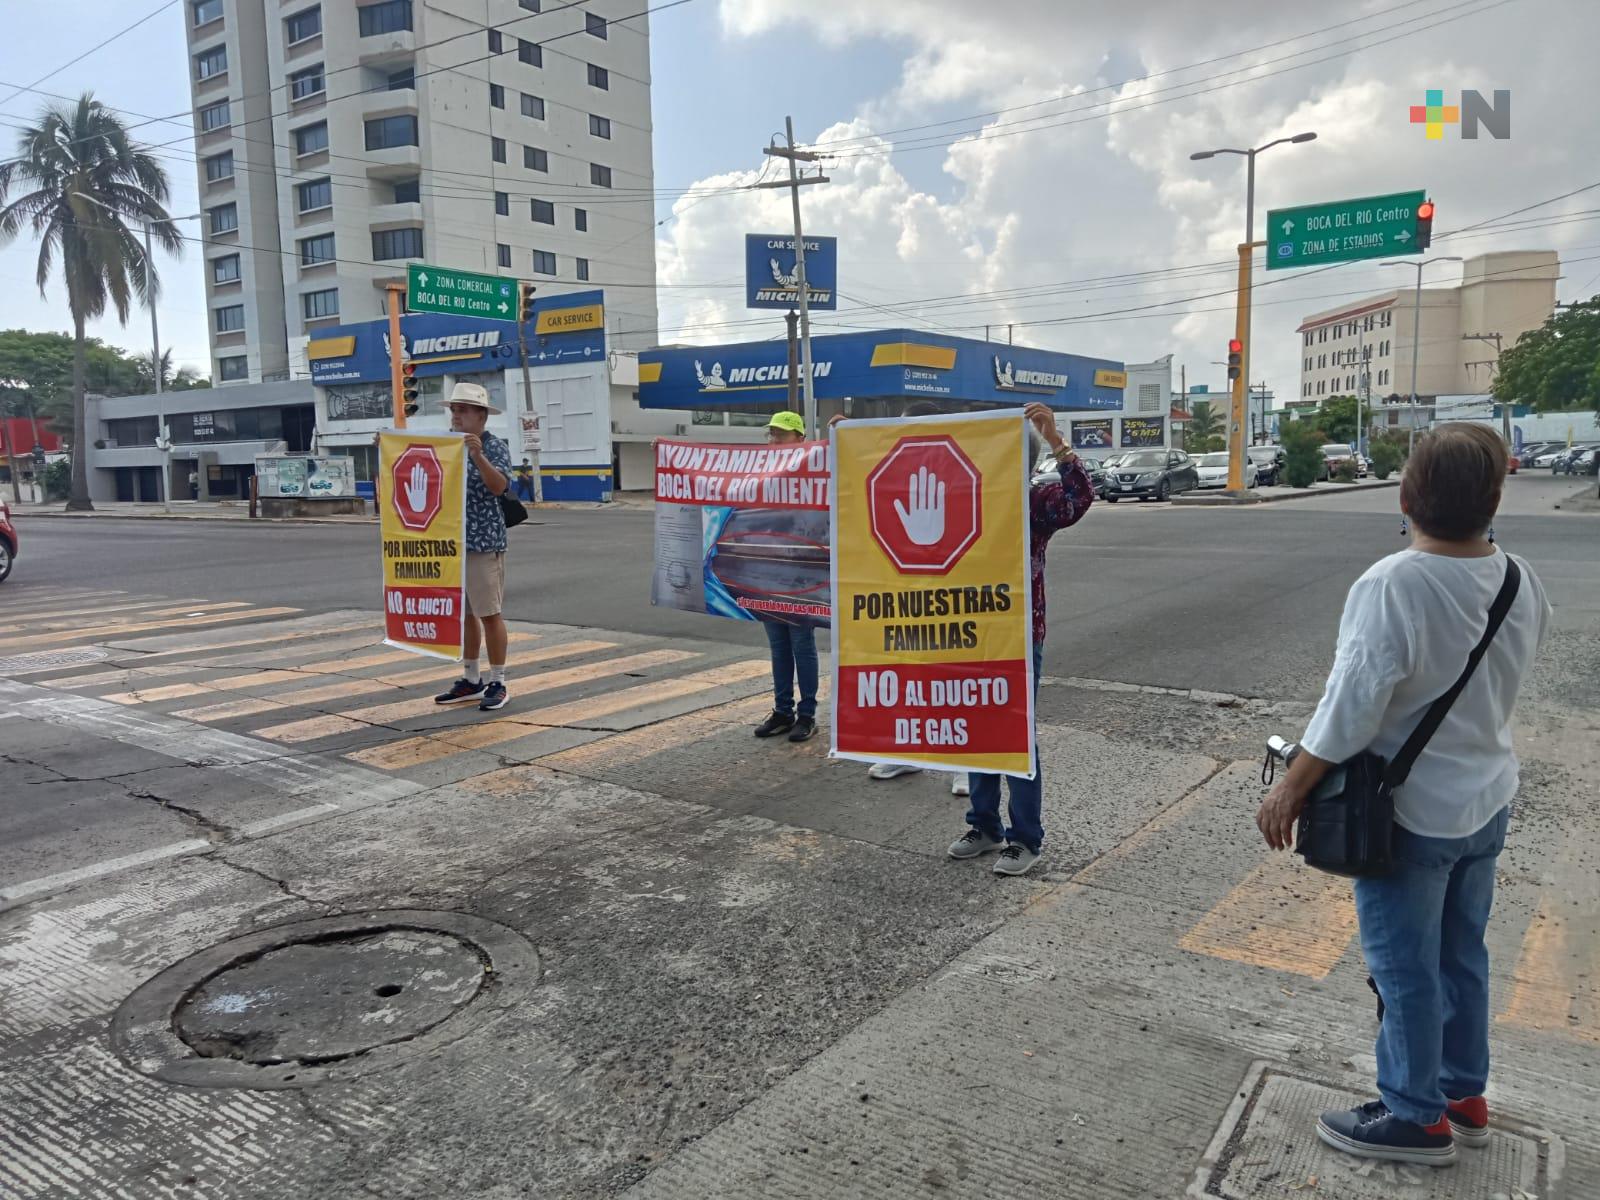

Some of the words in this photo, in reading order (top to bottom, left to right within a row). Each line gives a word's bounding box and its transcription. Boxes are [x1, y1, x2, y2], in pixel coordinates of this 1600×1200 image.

[1307, 215, 1332, 231] BOCA
[1335, 213, 1352, 227] DEL
[1356, 210, 1372, 225] RIO
[1376, 206, 1410, 223] Centro
[767, 240, 785, 249] CAR
[786, 241, 821, 251] SEVICE
[1302, 241, 1325, 255] ZONA
[1328, 238, 1339, 251] DE
[1343, 232, 1384, 250] ESTADIOS
[436, 275, 455, 289] ZONA
[457, 279, 494, 294] COMERCIAL
[417, 291, 436, 304] BOCA
[438, 294, 452, 307] DEL
[454, 296, 467, 309] RIO
[468, 298, 491, 311] Centro
[547, 316, 562, 326] CAR
[564, 312, 593, 325] SERVICE
[412, 330, 500, 355] MICHELIN
[1015, 369, 1068, 387] MICHELIN
[656, 442, 805, 473] AYUNTAMIENTO
[657, 472, 693, 499] BOCA
[694, 474, 725, 501] DEL
[726, 474, 760, 503] RÍO
[383, 540, 400, 557] POR
[402, 539, 457, 557] NUESTRAS
[394, 560, 441, 579] FAMILIAS
[387, 590, 403, 615] NO
[405, 597, 417, 615] AL
[418, 597, 453, 616] DUCTO
[853, 592, 895, 620] POR
[897, 583, 1011, 618] NUESTRAS
[404, 620, 416, 638] DE
[416, 621, 437, 640] GAS
[884, 621, 978, 652] FAMILIAS
[857, 670, 899, 708] NO
[905, 680, 927, 706] AL
[930, 677, 1009, 707] DUCTO
[894, 718, 921, 745] DE
[925, 718, 969, 746] GAS
